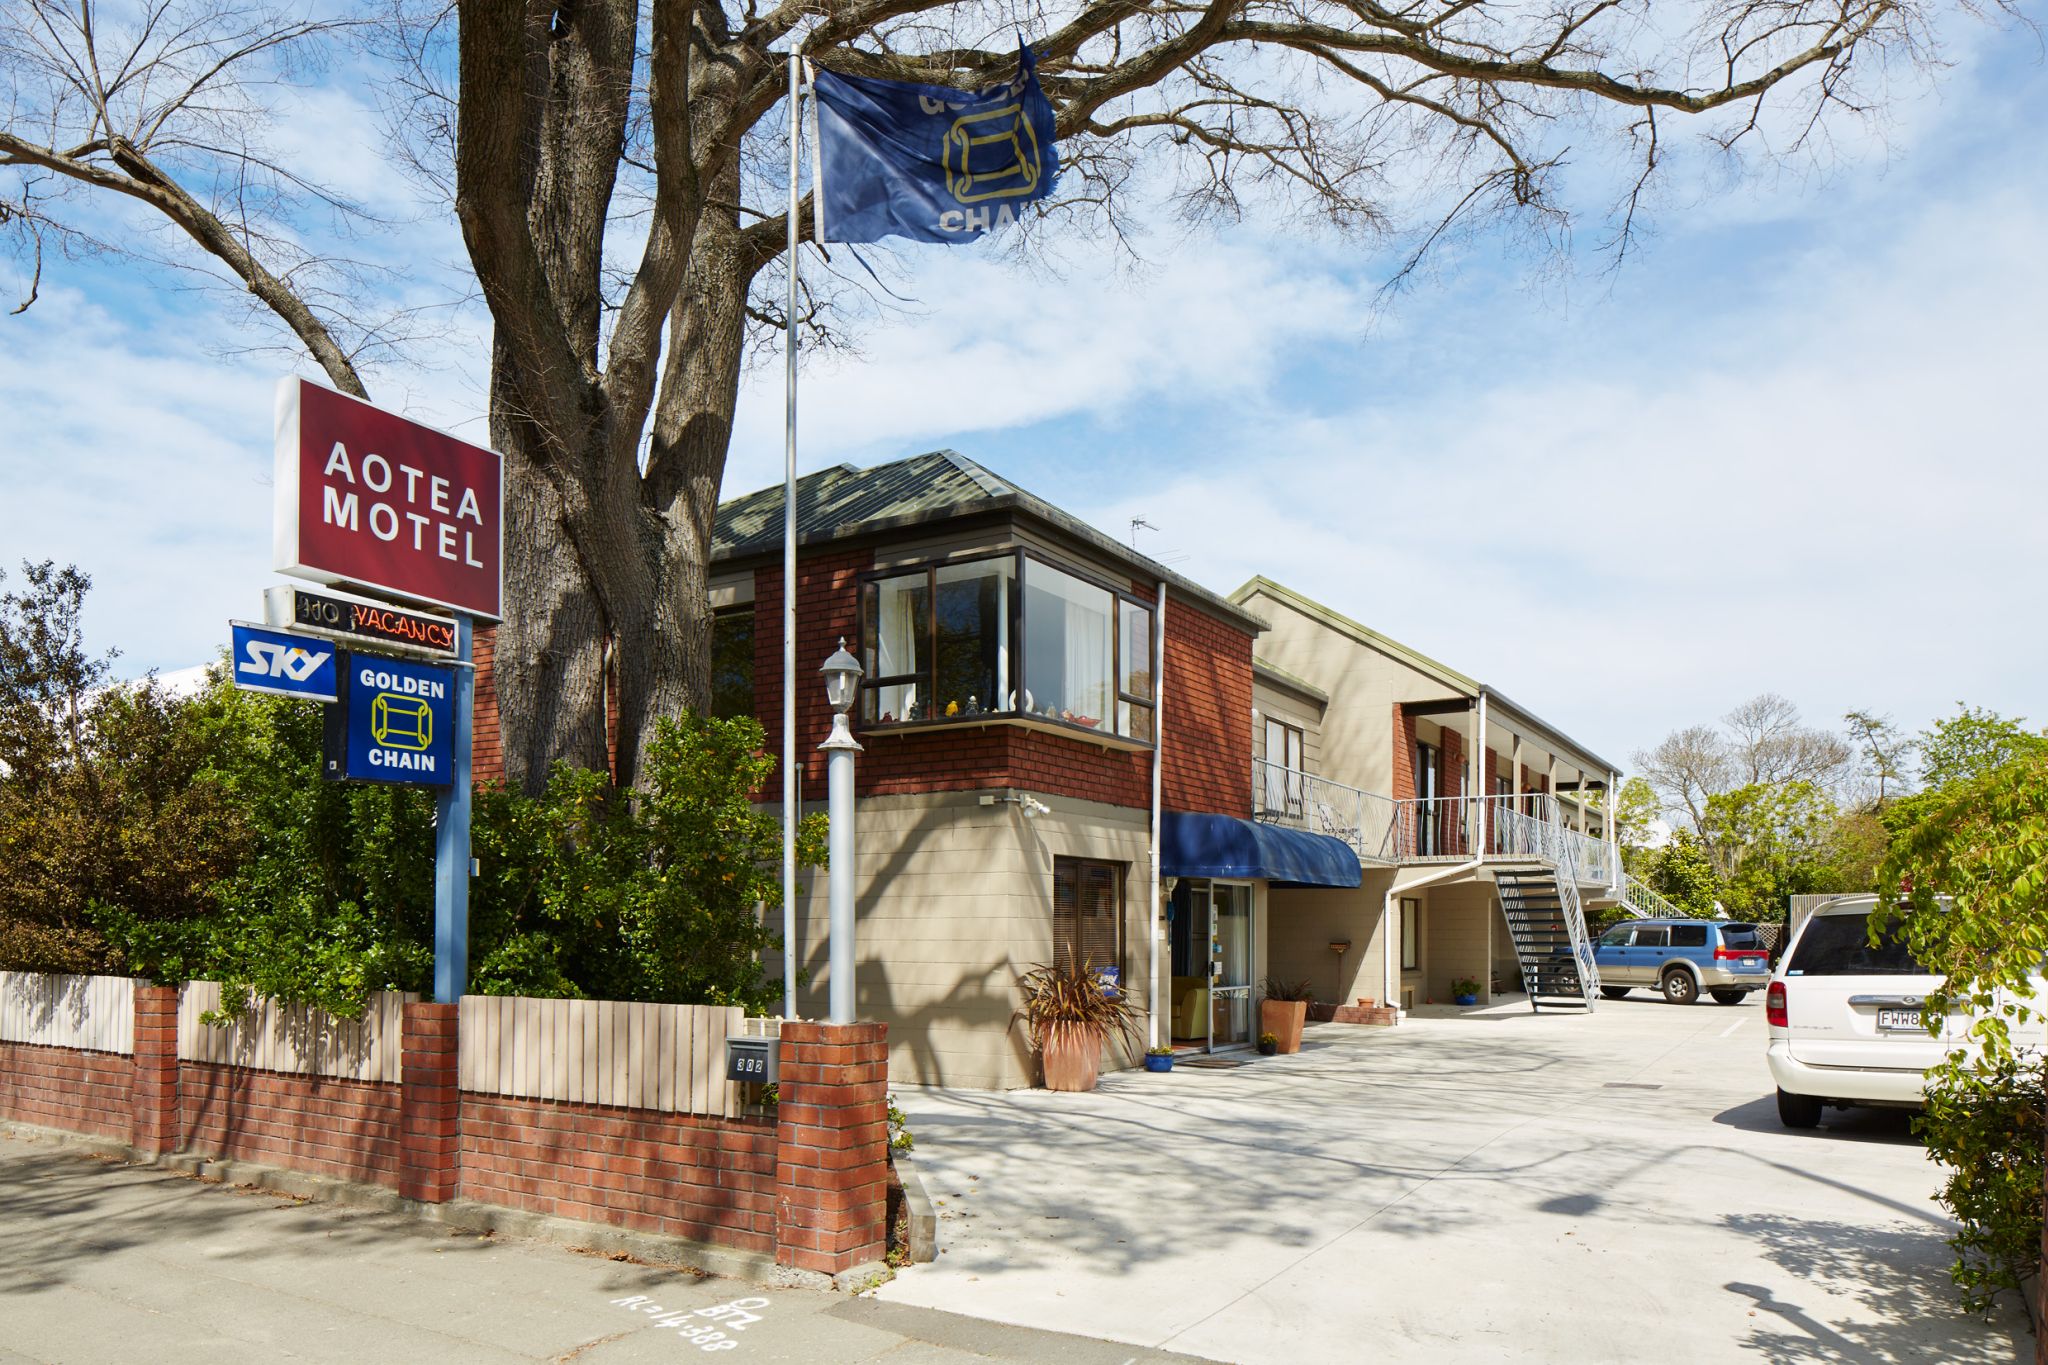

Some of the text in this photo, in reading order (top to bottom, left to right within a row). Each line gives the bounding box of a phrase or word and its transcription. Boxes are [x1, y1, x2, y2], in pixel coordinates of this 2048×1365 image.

[323, 441, 483, 526] AOTEA
[323, 485, 483, 569] MOTEL
[297, 596, 454, 646] NO VACANCY
[239, 640, 332, 682] SKY
[360, 669, 445, 699] GOLDEN
[368, 748, 435, 772] CHAIN
[737, 1058, 763, 1073] 302
